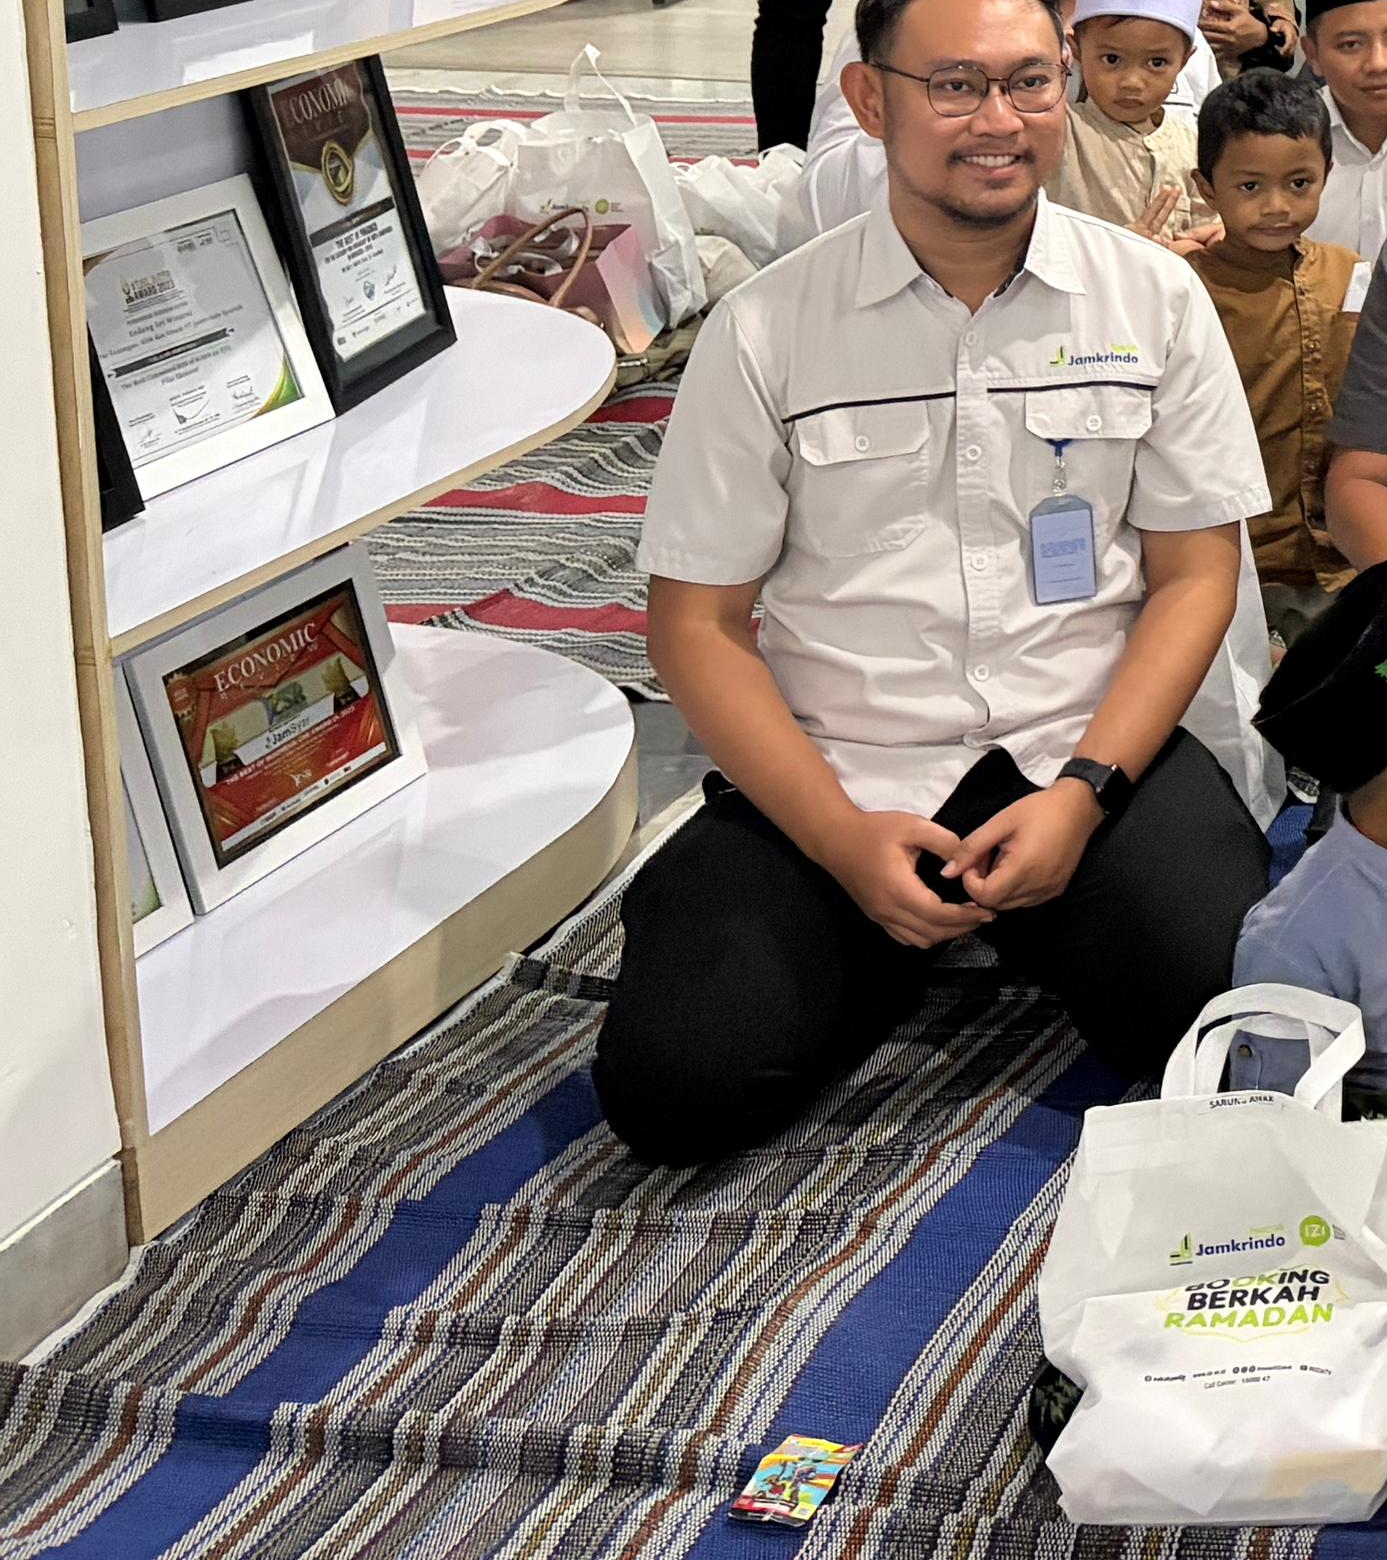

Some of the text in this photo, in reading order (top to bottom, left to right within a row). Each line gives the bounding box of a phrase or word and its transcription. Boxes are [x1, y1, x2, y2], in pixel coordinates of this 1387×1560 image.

[1067, 351, 1138, 366] Jamkrindo
[214, 623, 317, 692] ECONOMIC
[1195, 1234, 1286, 1256] Jamkrindo
[1187, 1285, 1321, 1312] BERKAH
[1163, 1302, 1335, 1329] RAMADAN
